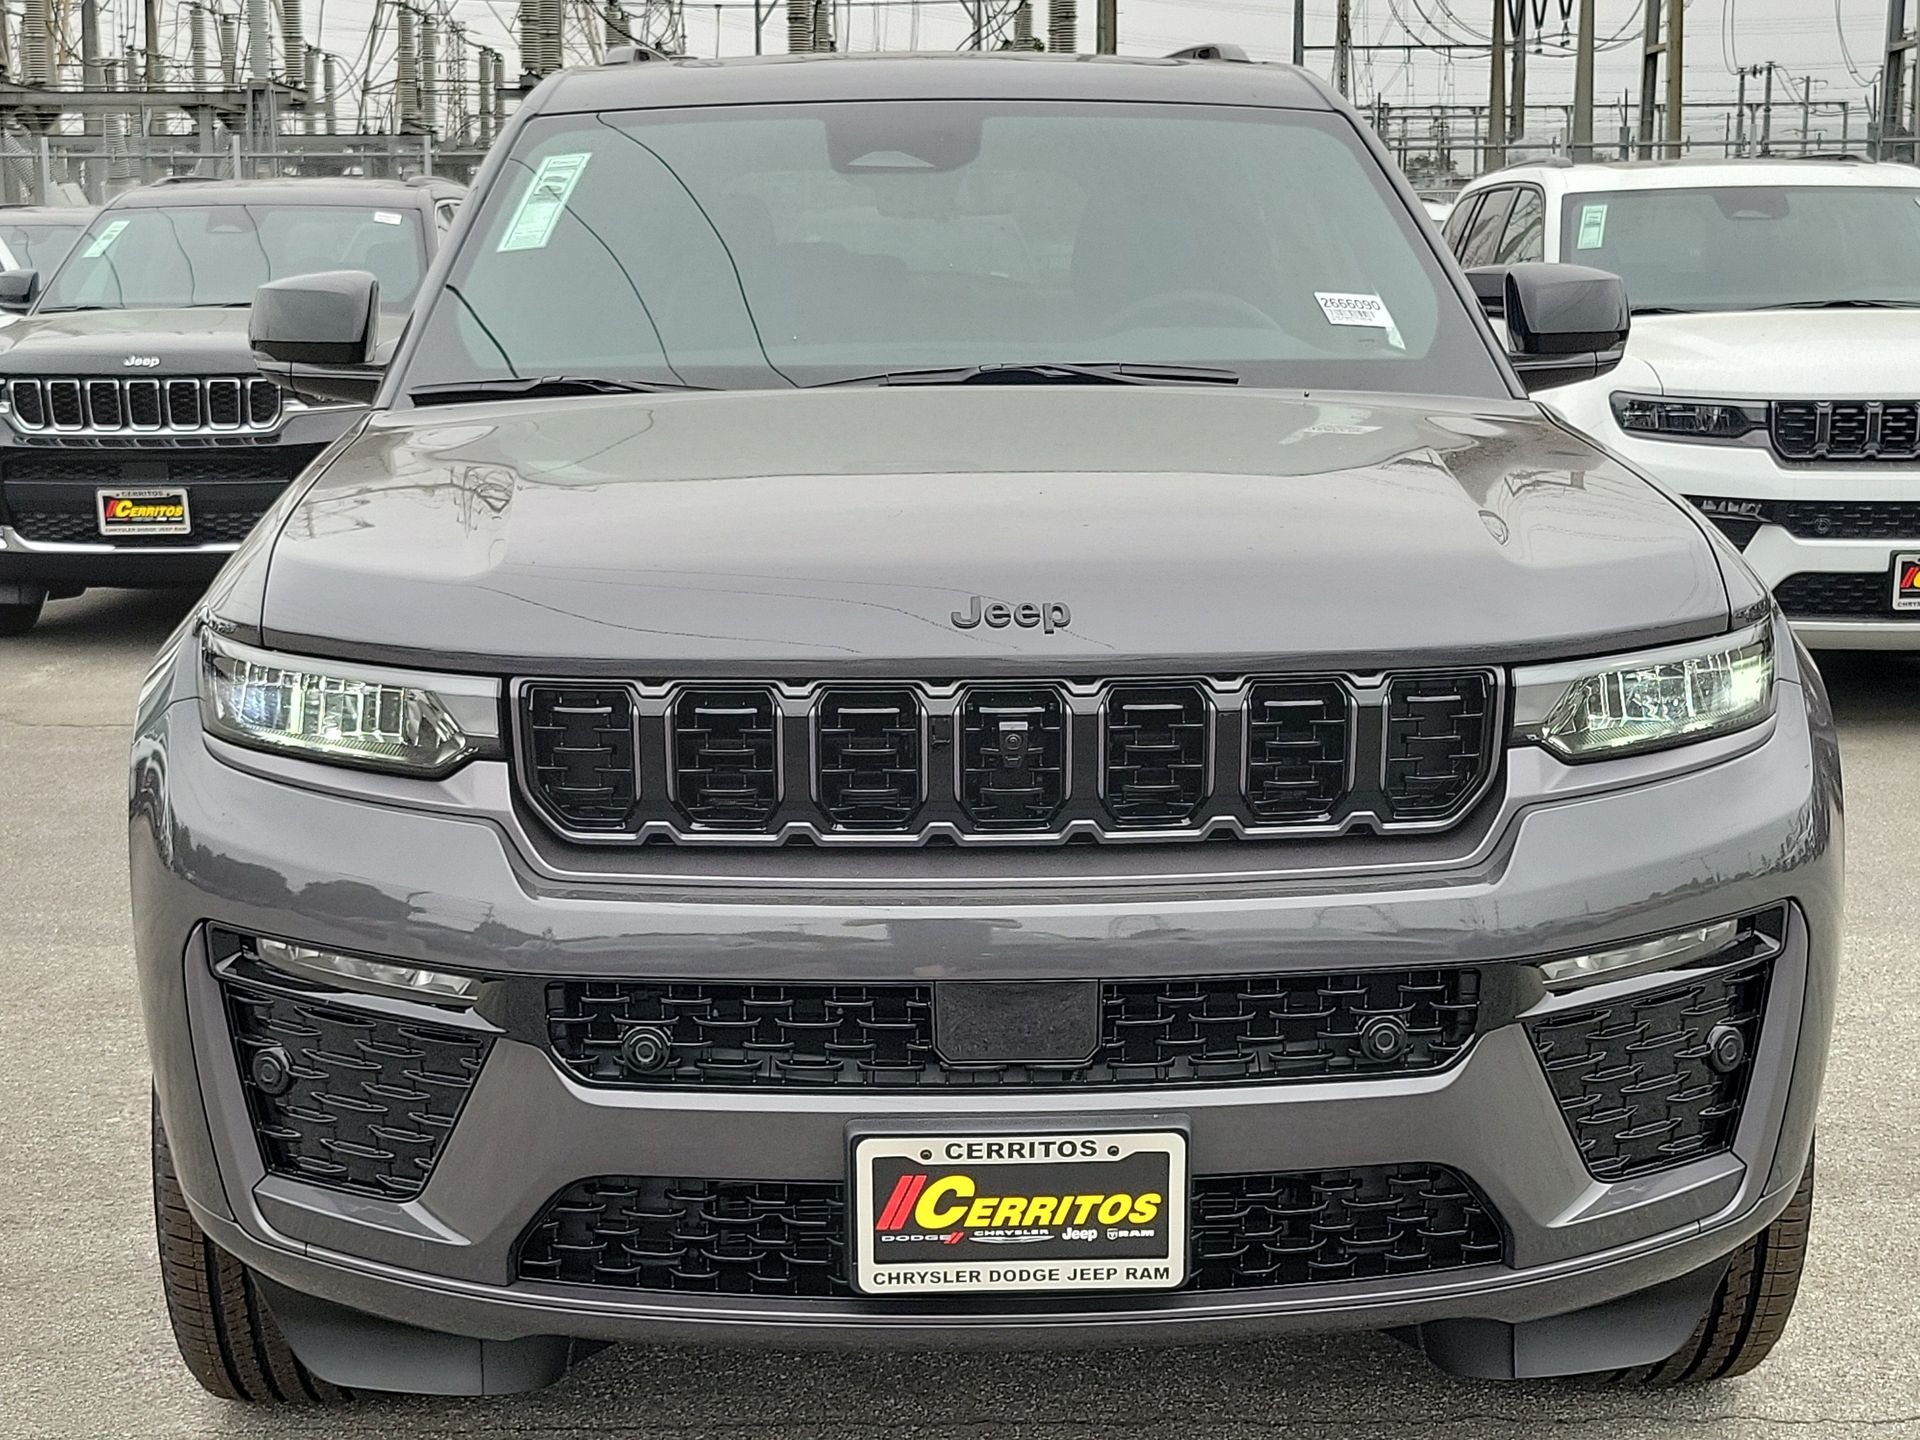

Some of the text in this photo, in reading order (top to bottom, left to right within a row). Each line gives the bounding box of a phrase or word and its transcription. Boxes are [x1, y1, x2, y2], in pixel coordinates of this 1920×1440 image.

[1320, 297, 1381, 311] 2666090
[124, 356, 160, 368] Jeep
[950, 596, 1071, 635] Jeep
[945, 1140, 1097, 1160] CERRITOS
[881, 1234, 952, 1243] DODGE
[973, 1229, 1050, 1237] CHRYSLER
[1062, 1227, 1098, 1242] Jeep
[1118, 1228, 1155, 1239] RAM
[873, 1265, 1170, 1286] CHRYSLER DODGE JEEP RAM
